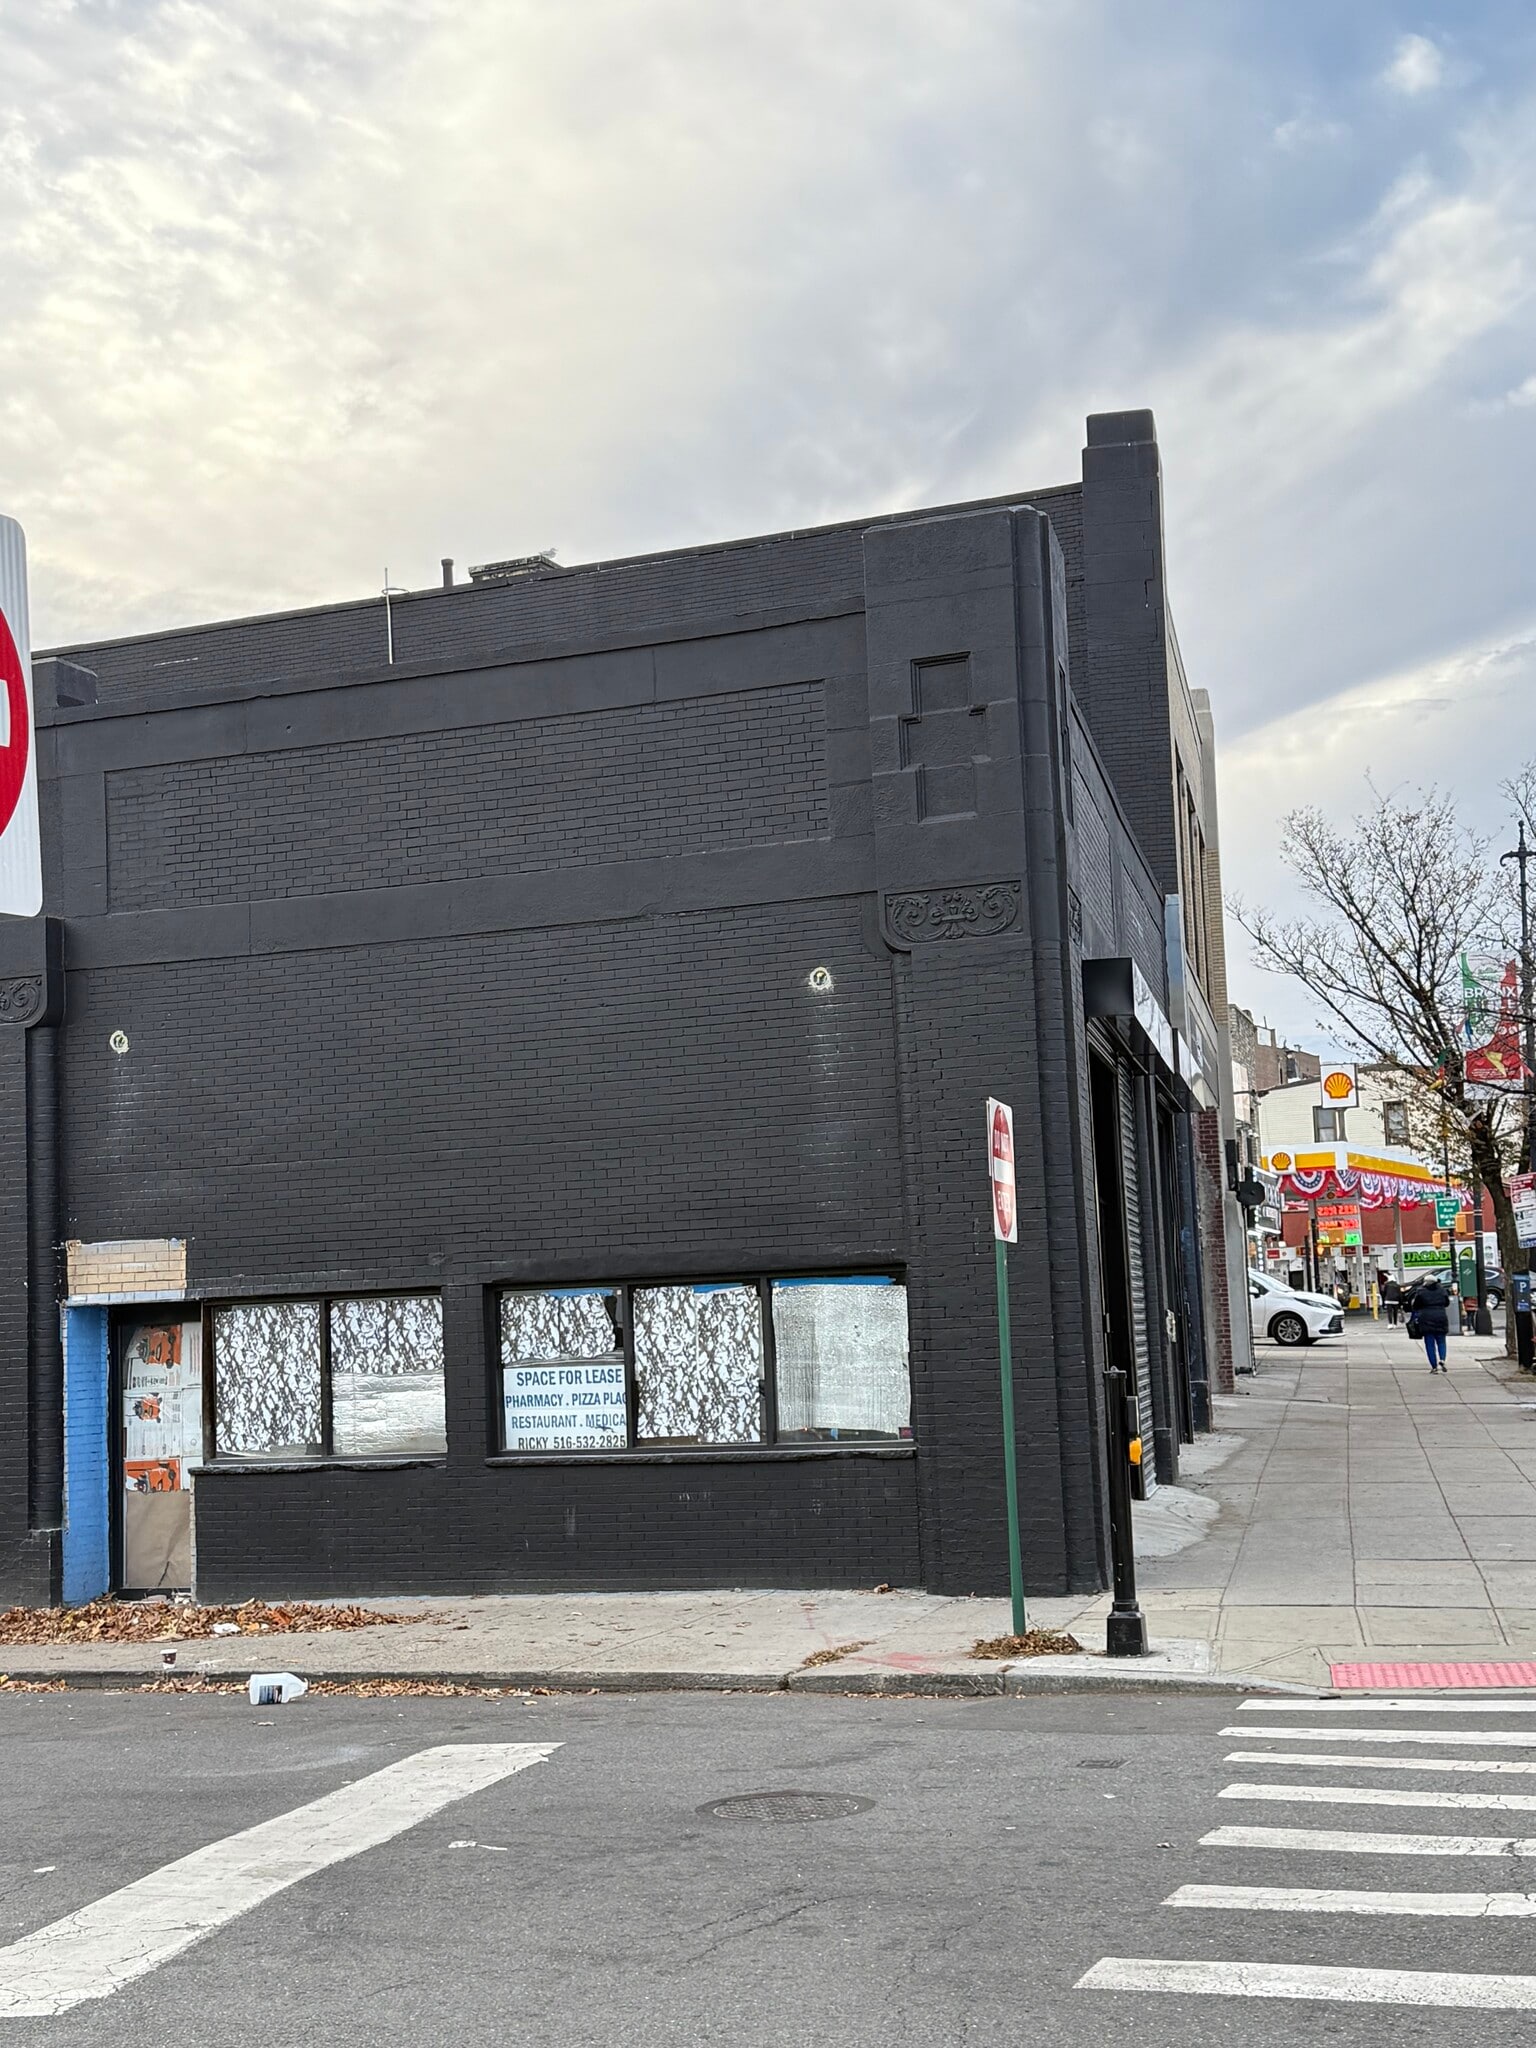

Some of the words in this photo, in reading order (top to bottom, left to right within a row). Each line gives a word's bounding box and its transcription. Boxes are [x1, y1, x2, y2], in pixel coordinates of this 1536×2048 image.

[1464, 986, 1516, 998] BRONX
[517, 1371, 556, 1386] SPACE
[559, 1370, 582, 1385] FOR
[586, 1368, 623, 1384] LEASE
[506, 1393, 563, 1408] PHARMACY
[572, 1392, 601, 1406] PIZZA
[511, 1414, 578, 1429] RESTAURANT
[518, 1437, 549, 1450] RICKY
[553, 1435, 626, 1449] 516-532-2825
